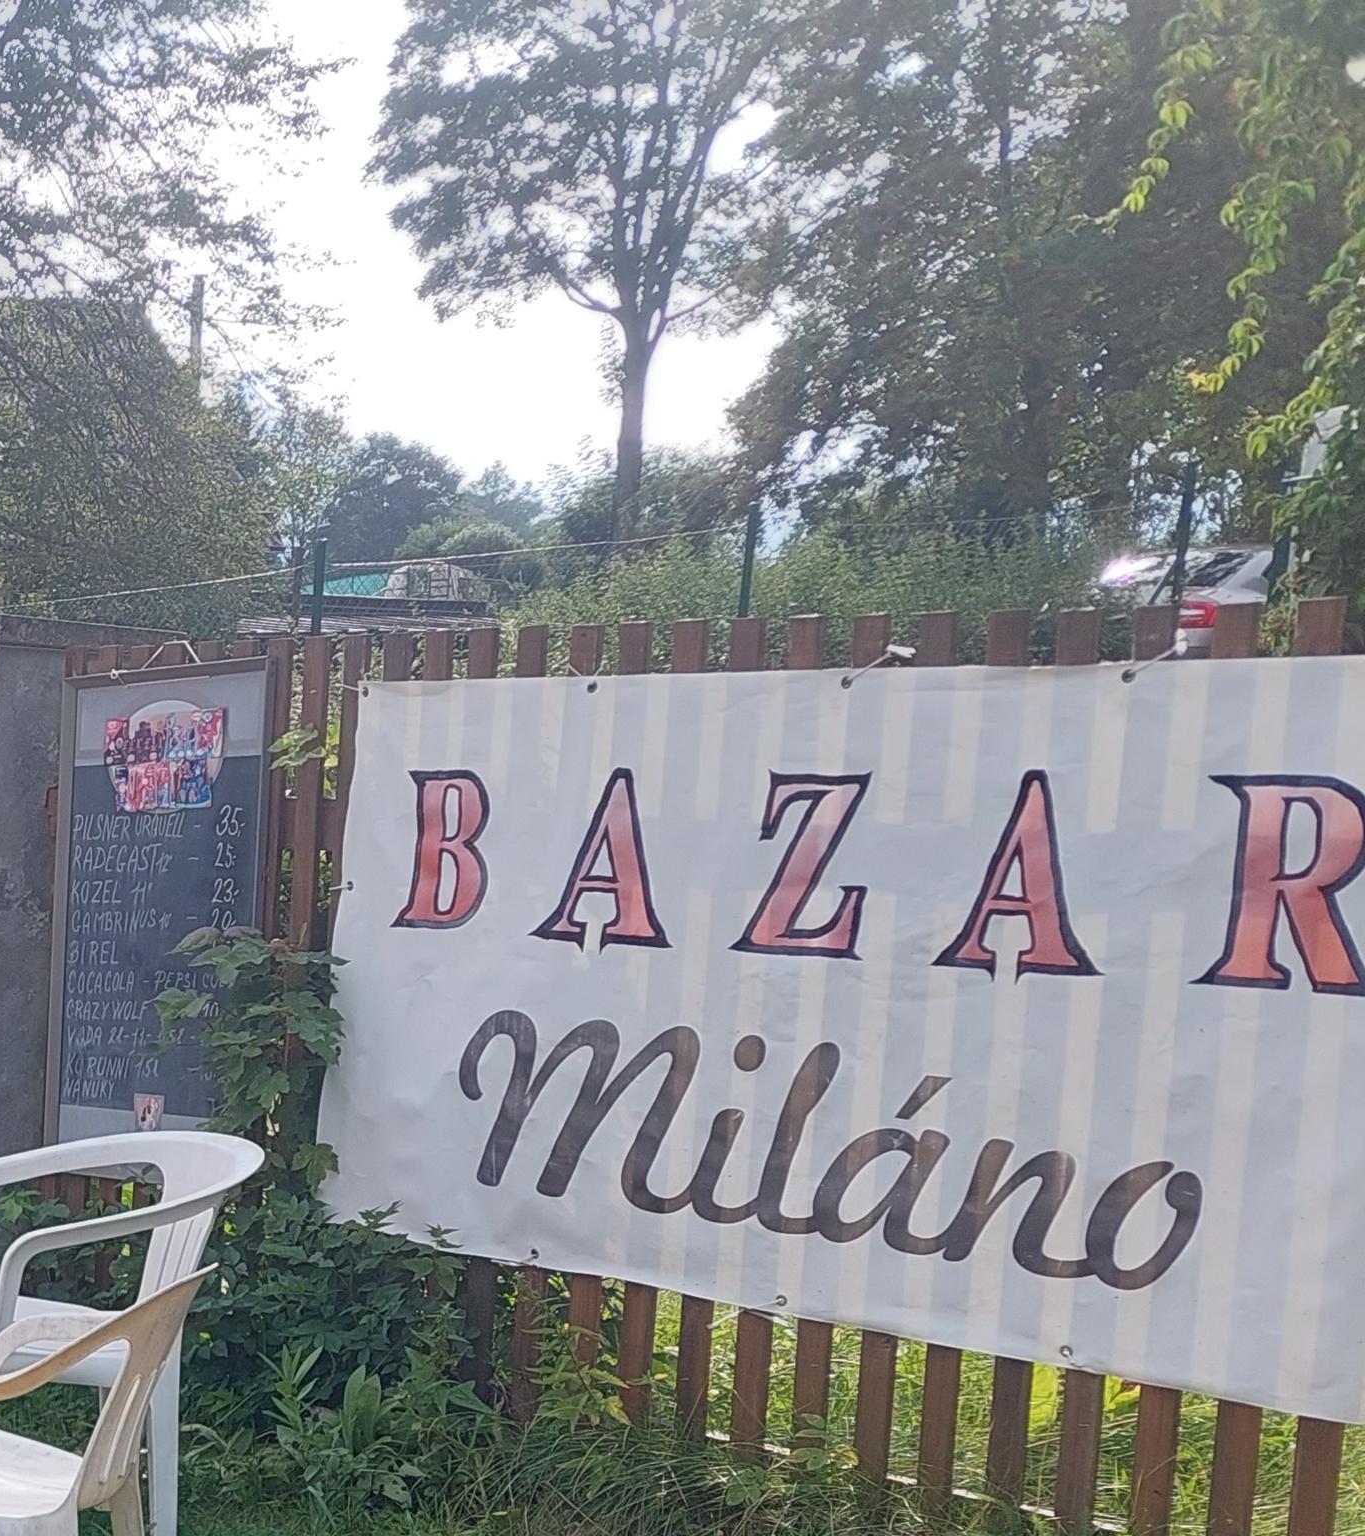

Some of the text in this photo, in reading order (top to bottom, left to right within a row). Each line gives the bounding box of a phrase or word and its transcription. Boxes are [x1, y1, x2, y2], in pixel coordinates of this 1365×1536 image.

[73, 813, 131, 841] PILSNER
[134, 812, 186, 838] URQUELL
[72, 843, 162, 877] RADEGAST
[71, 878, 122, 904] KOZEL
[391, 766, 1365, 997] BAZAR
[71, 908, 157, 934] GAMBRINUS
[68, 940, 119, 965] BIREL
[154, 970, 197, 992] PEPSI
[459, 1010, 1203, 1291] Miláno
